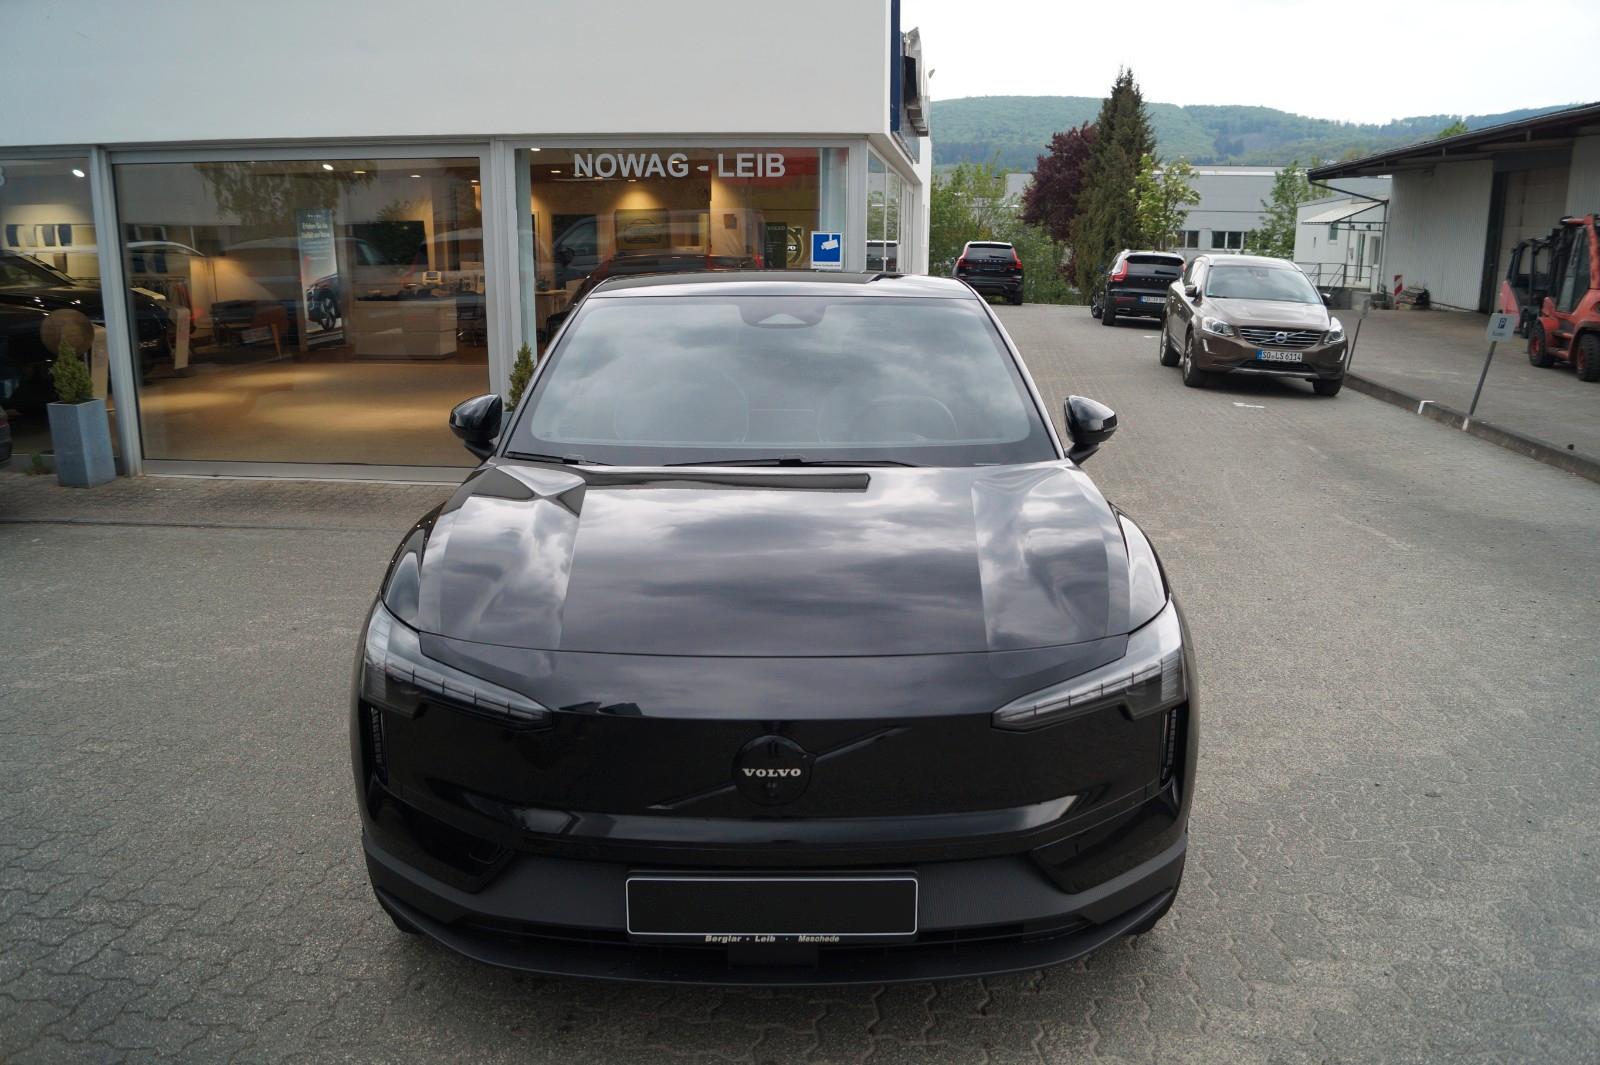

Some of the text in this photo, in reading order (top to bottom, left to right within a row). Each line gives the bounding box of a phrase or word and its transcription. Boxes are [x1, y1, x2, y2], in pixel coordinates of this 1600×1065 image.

[573, 153, 689, 178] NOWAG
[717, 153, 786, 177] LEIB
[742, 768, 802, 777] VOLVO
[705, 935, 741, 944] Berglar
